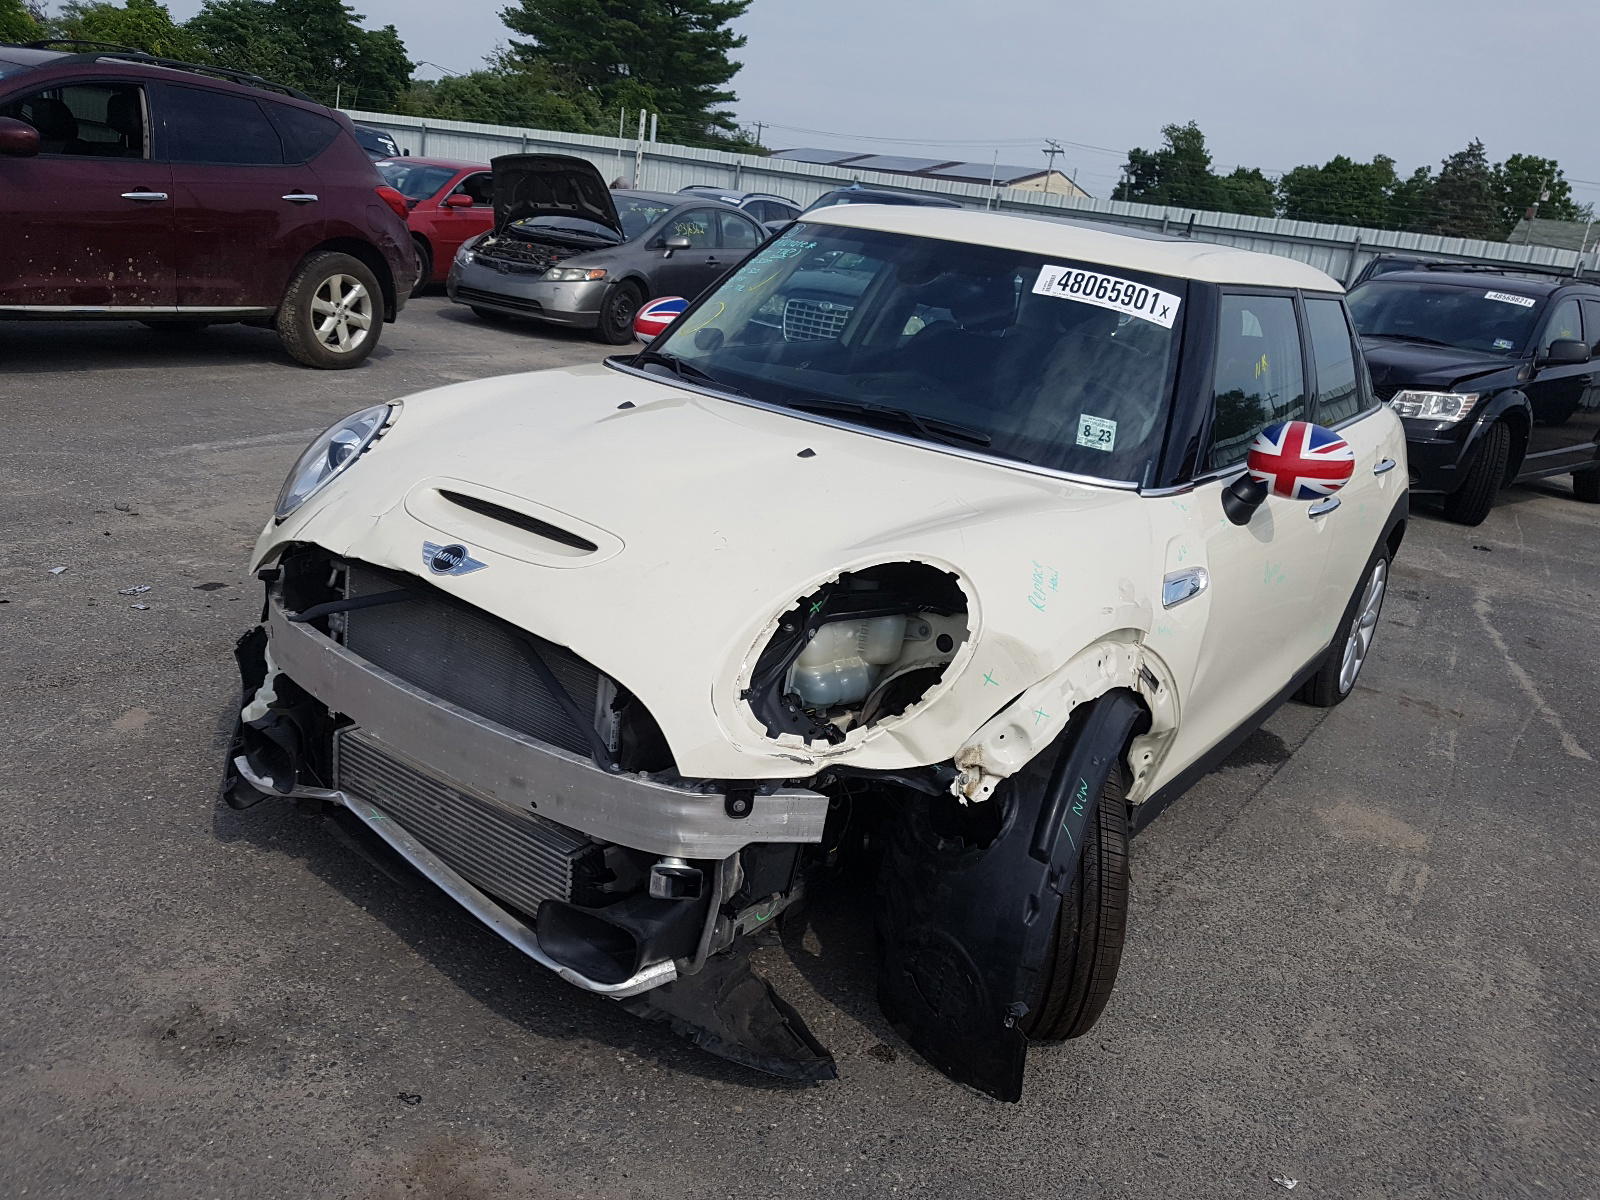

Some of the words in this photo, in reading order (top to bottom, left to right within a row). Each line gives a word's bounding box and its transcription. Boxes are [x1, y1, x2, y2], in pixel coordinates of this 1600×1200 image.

[1057, 271, 1160, 314] 48065901
[1084, 425, 1091, 437] 8
[1098, 429, 1111, 442] 23
[435, 551, 461, 566] MINI
